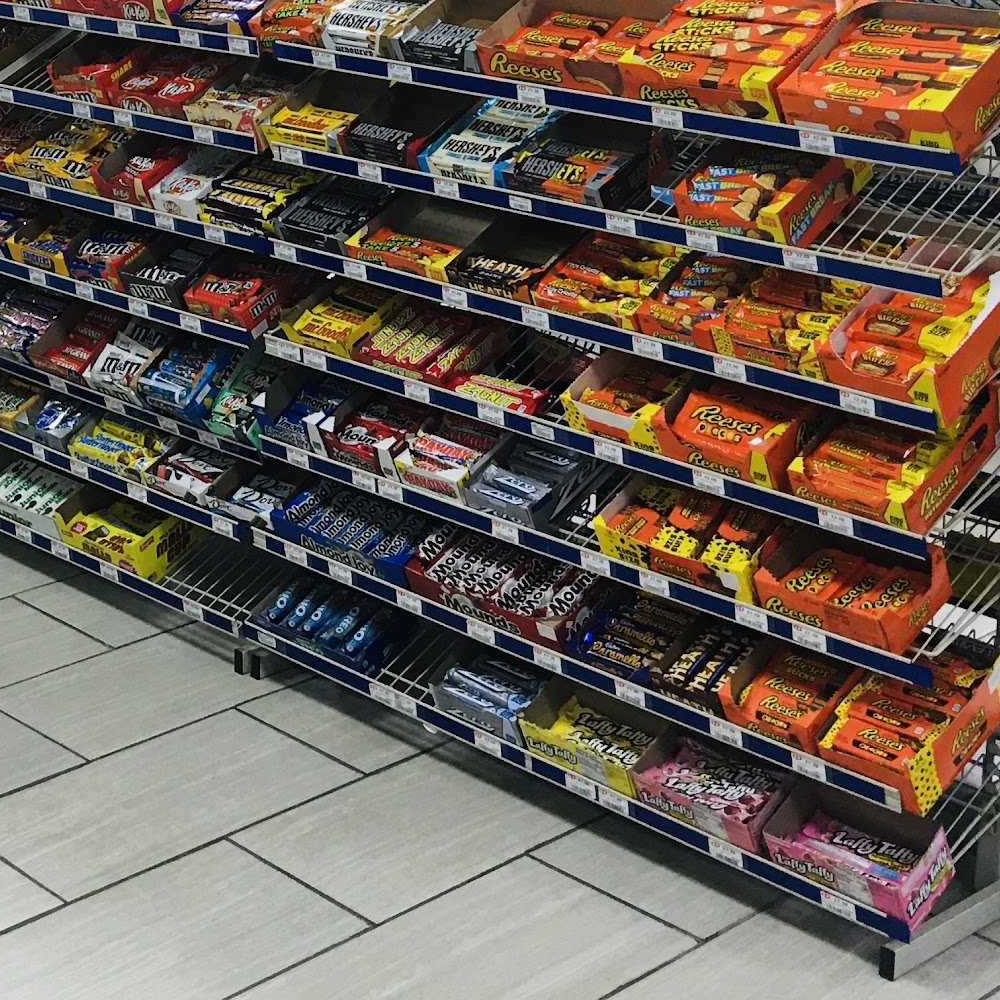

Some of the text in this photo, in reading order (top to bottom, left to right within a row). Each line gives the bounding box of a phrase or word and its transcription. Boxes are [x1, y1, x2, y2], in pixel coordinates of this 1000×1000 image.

[330, 11, 386, 30] HERSHEY'S
[652, 41, 715, 51] STICKS
[111, 61, 133, 83] SHARE
[490, 53, 563, 82] Reese's
[351, 122, 413, 144] HERSHEY'S
[469, 119, 528, 139] HERSHEY'S
[443, 139, 501, 160] HERSHEY'S
[920, 139, 939, 148] KING
[523, 157, 584, 181] HERSHEY'S
[288, 209, 352, 233] HERSHEY'S
[474, 257, 528, 277] HEATH
[455, 382, 521, 407] ZAGNUT
[691, 405, 761, 434] Reese's
[415, 437, 469, 461] PAYDAY
[688, 452, 740, 478] Reese's
[301, 534, 350, 565] Almond
[785, 557, 833, 592] Reese's
[447, 598, 520, 635] Mounds
[765, 597, 822, 628] Reese's
[760, 696, 801, 719] Reese's
[577, 713, 652, 745] Laffy Taffy
[857, 728, 904, 750] Reese's
[528, 738, 577, 764] Laffy Taffy
[666, 778, 705, 796] Laffy
[642, 791, 694, 818] Laffy Taffy
[830, 831, 920, 864] Laffy Taffy
[775, 851, 834, 883] Laffy Taffy
[907, 848, 948, 917] Laffy Taffy
